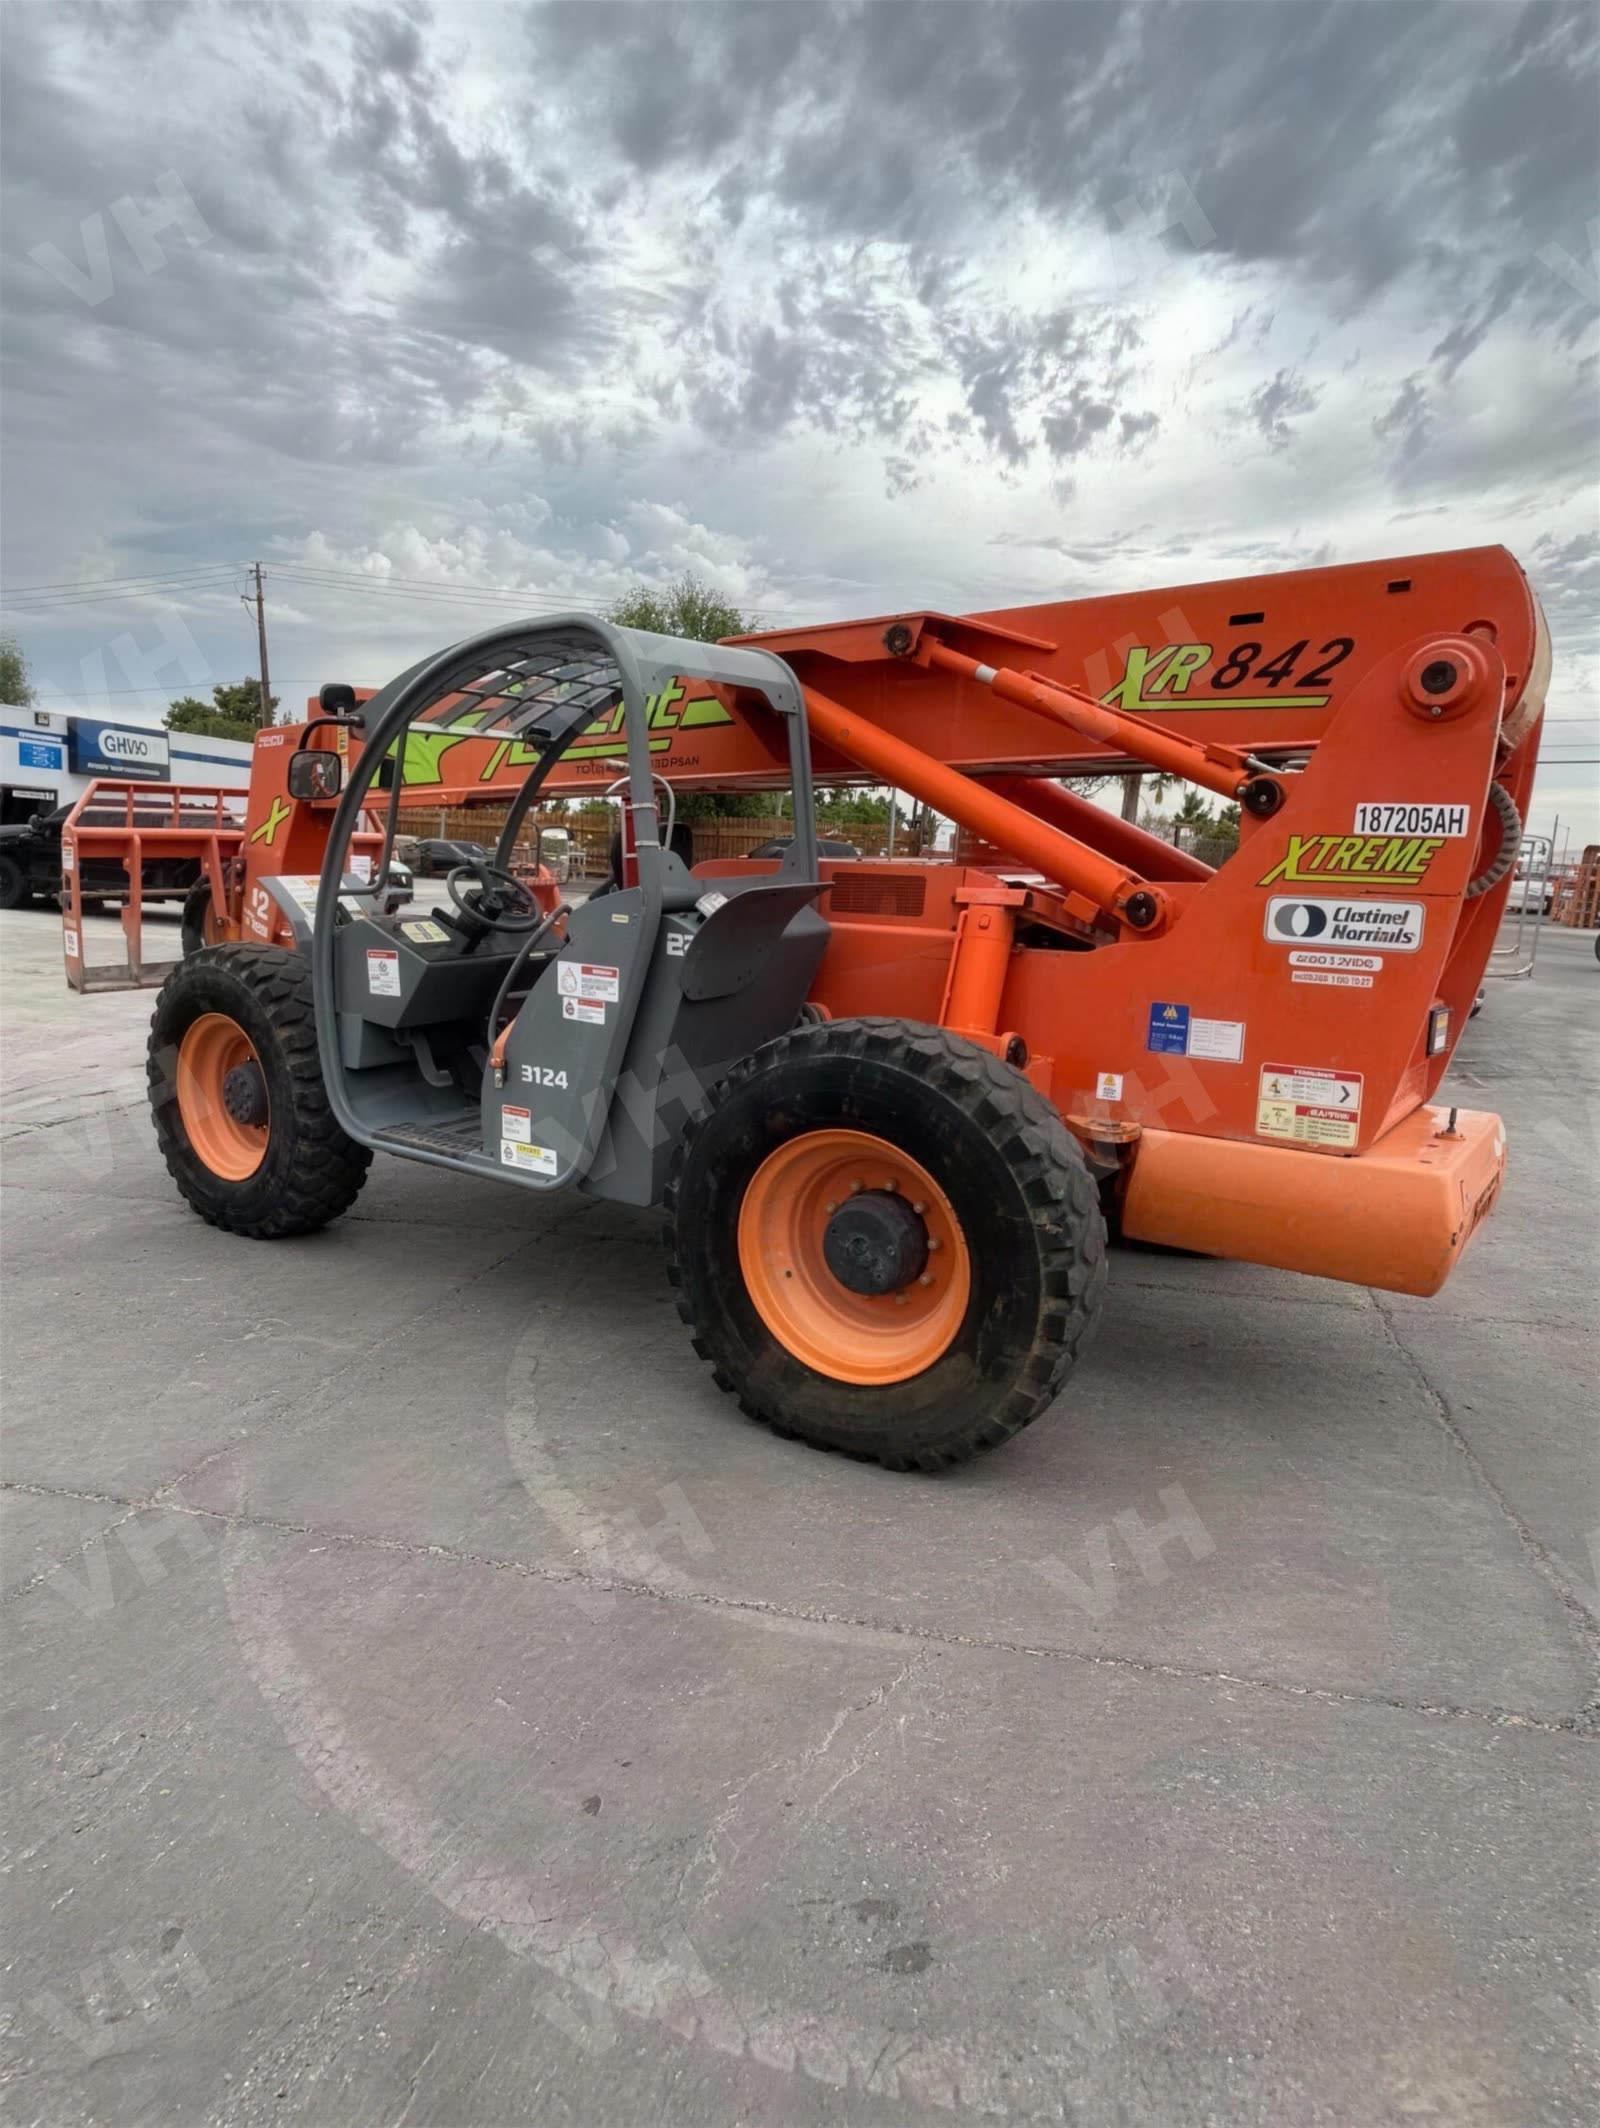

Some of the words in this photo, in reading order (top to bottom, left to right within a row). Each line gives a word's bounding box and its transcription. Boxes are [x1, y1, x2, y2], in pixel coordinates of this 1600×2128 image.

[1099, 643, 1213, 710] XR
[1210, 637, 1354, 690] 842
[1359, 806, 1464, 834] 187205AH
[1256, 835, 1446, 886] XTREME
[521, 1064, 568, 1089] 3124
